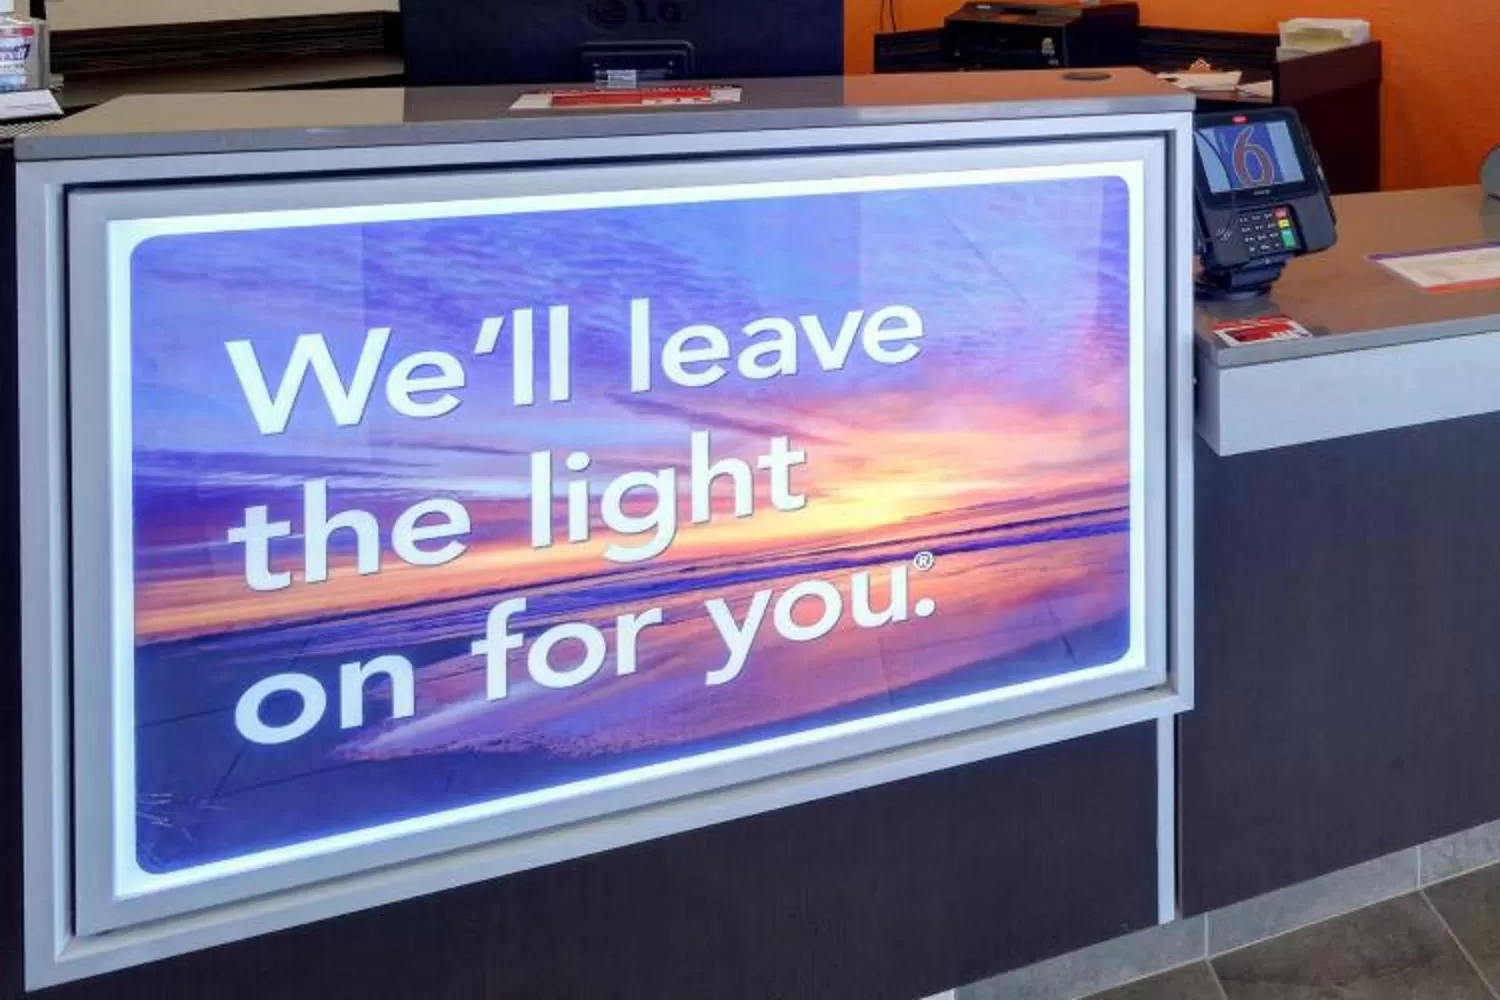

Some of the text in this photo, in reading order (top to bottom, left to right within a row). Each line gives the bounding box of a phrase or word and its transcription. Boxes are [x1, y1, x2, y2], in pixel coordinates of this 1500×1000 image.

[635, 0, 685, 23] LG
[1232, 125, 1276, 187] 6
[225, 298, 925, 435] We'll leave
[228, 431, 806, 593] the light
[234, 650, 416, 746] on
[471, 598, 664, 701] for
